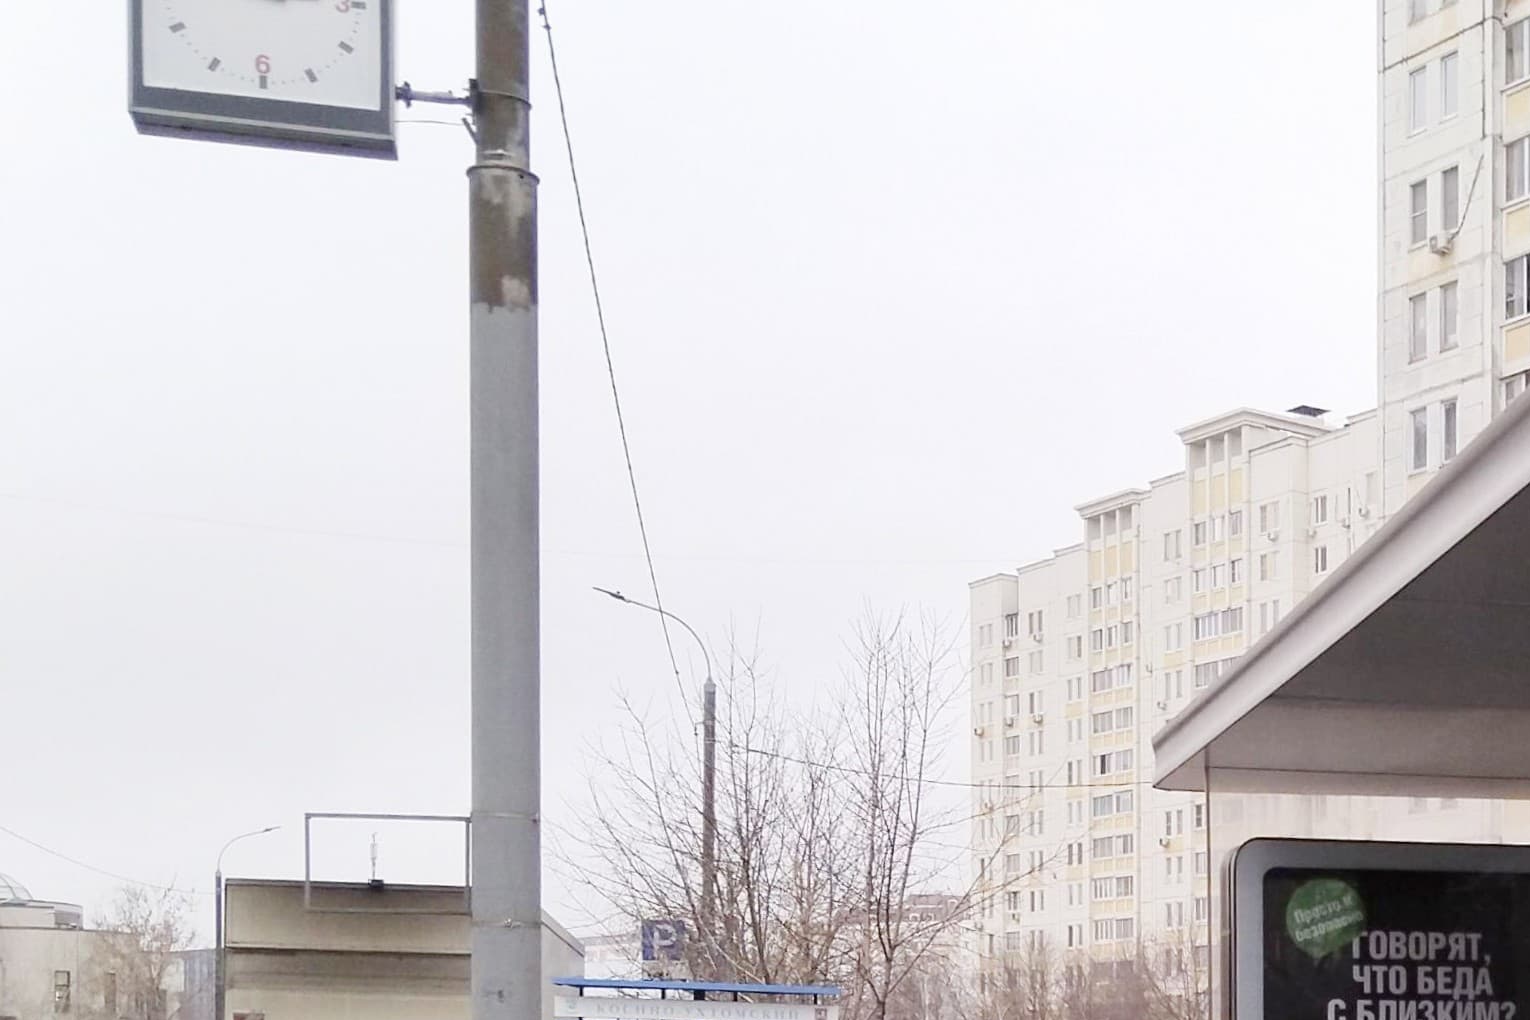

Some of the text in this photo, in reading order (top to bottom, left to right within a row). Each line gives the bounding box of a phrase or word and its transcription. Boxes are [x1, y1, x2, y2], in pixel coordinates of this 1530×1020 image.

[255, 54, 271, 74] 6
[653, 923, 677, 959] P
[1352, 930, 1491, 967] ГОВОРЯТ,
[1352, 965, 1493, 1001] ЧТО БЕДА
